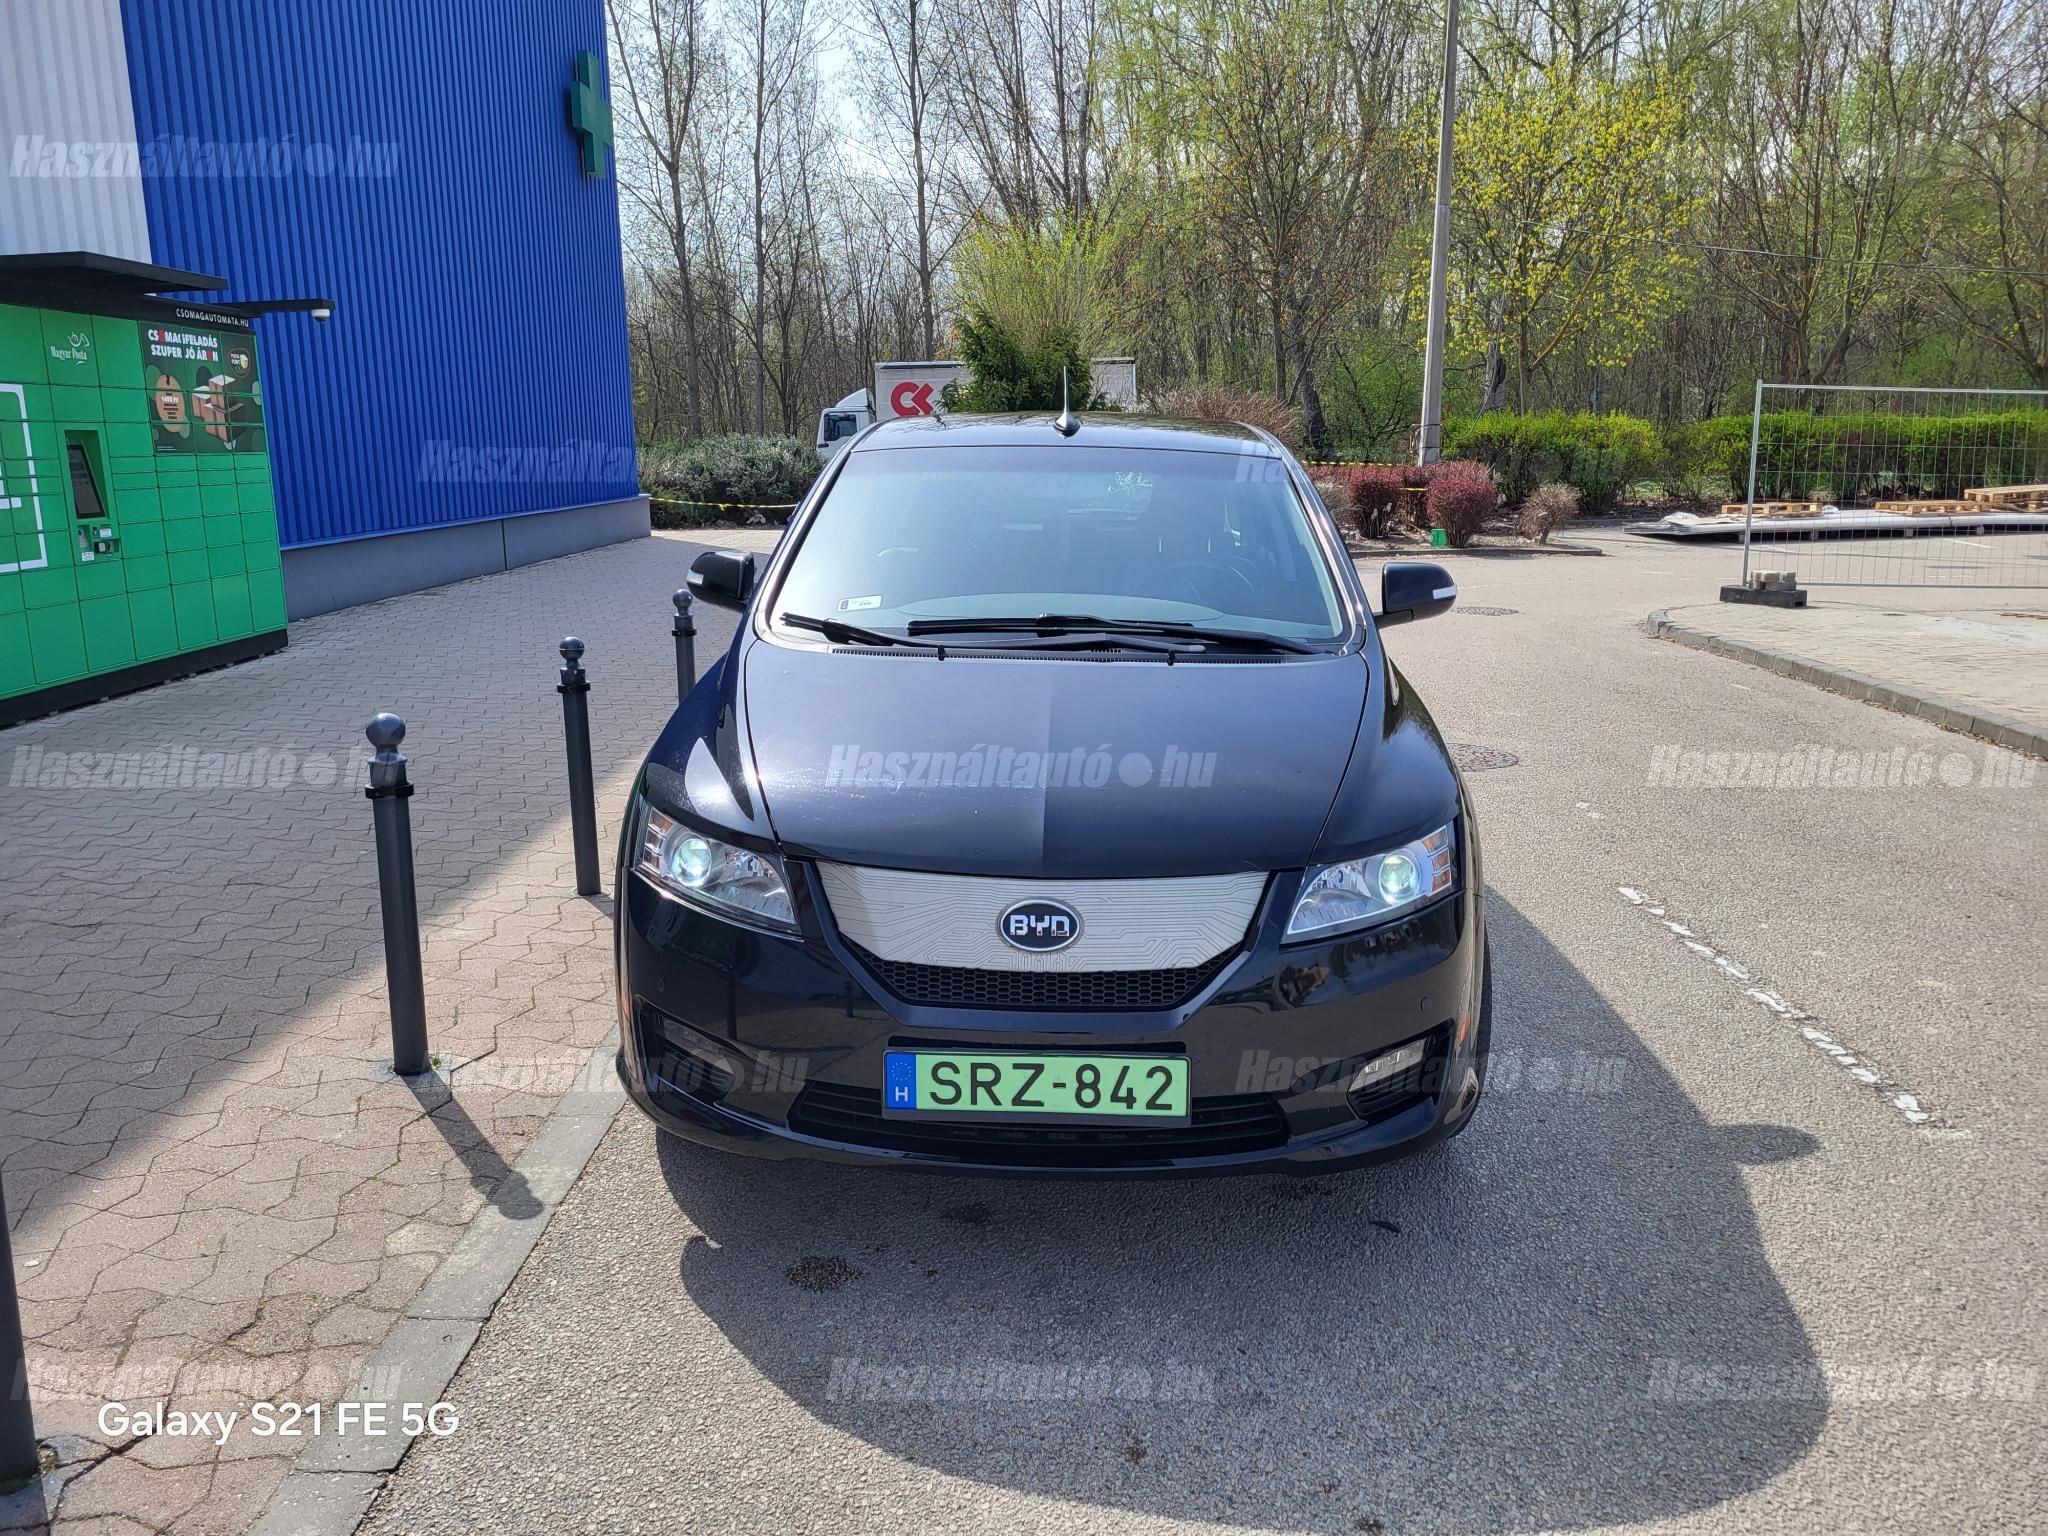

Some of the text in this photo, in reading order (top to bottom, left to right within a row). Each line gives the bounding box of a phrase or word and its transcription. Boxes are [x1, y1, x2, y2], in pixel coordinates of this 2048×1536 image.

[175, 308, 249, 328] CSOMAGAUTOMATA.HU
[150, 343, 182, 359] SZUPER
[185, 346, 196, 361] JÓ
[1009, 914, 1070, 937] BYD
[894, 1086, 909, 1102] H
[929, 1061, 1174, 1110] SRZ-842
